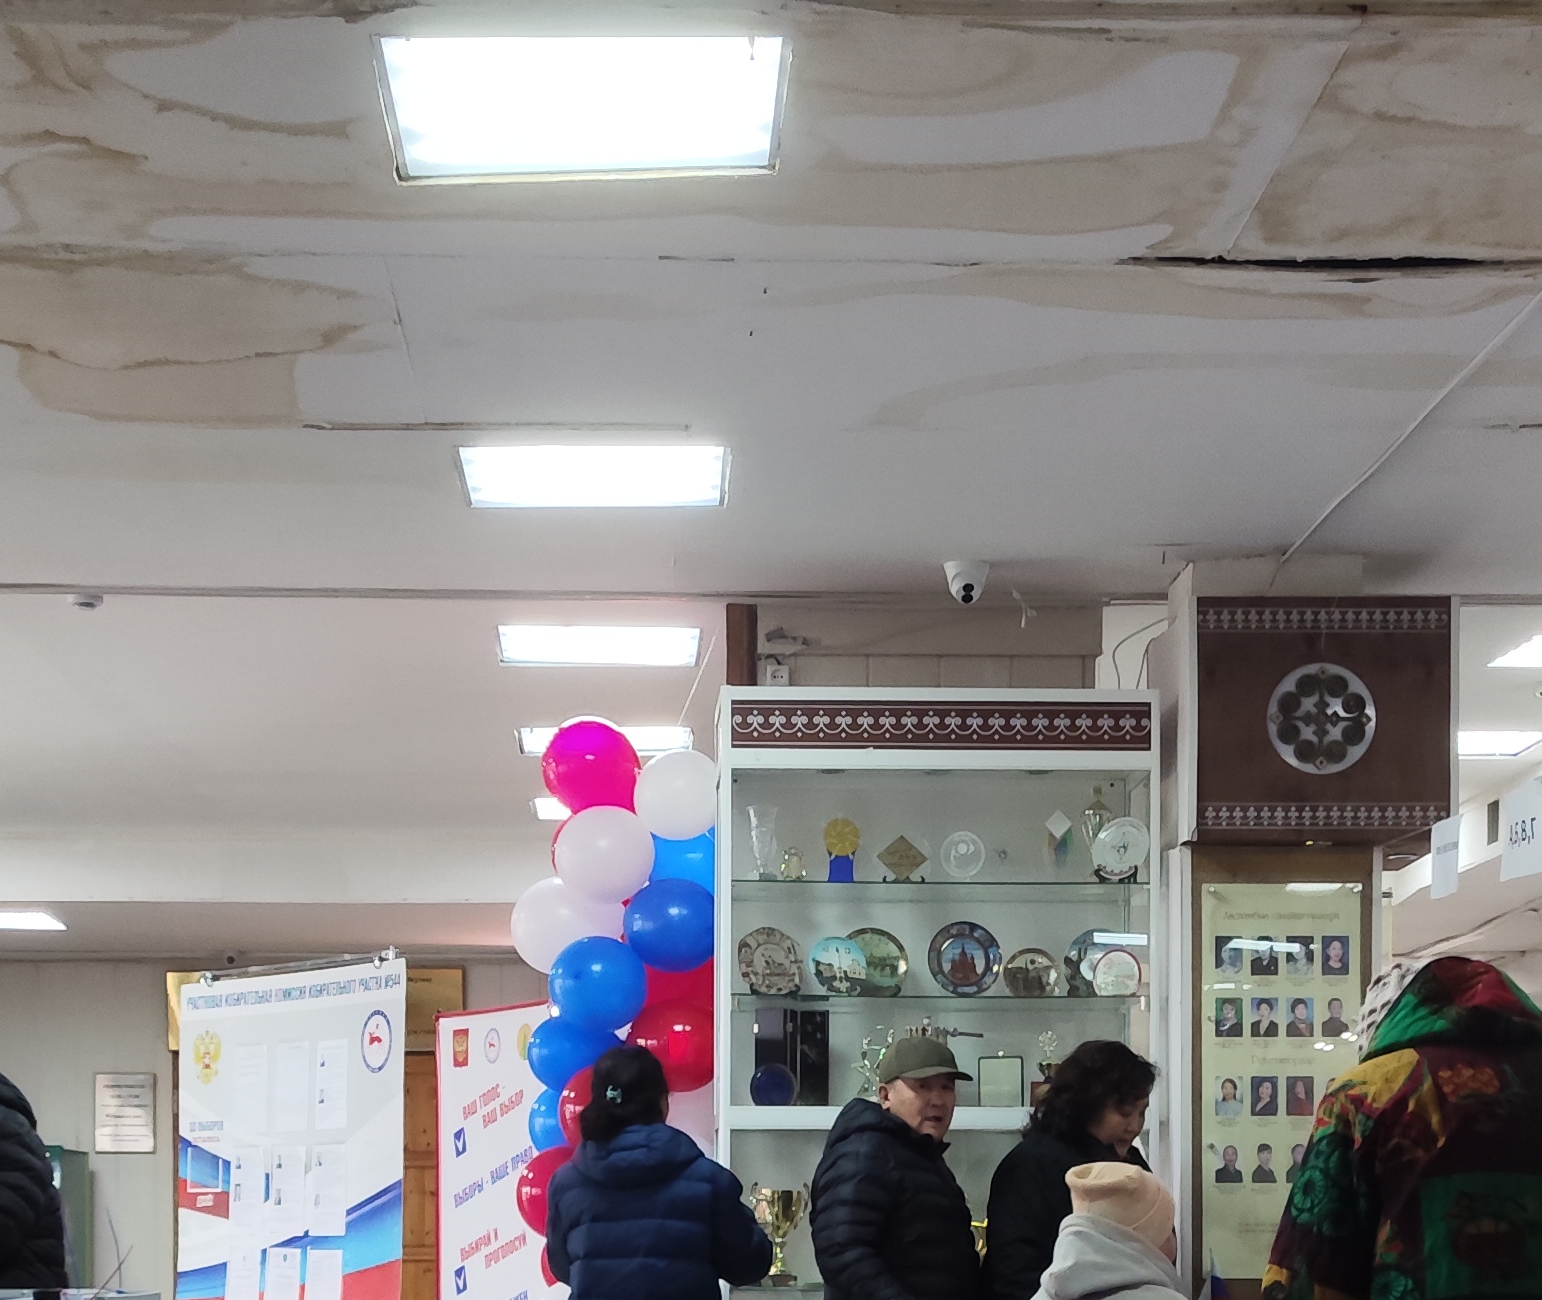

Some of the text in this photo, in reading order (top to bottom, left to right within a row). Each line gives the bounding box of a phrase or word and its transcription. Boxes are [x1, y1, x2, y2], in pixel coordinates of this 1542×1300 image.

[463, 1099, 477, 1120] ВАШ
[479, 1084, 500, 1109] ГОЛОС
[482, 1089, 524, 1129] ВАШ ВЫБОР
[454, 1177, 484, 1208] ВЫБОРЫ
[490, 1161, 509, 1185] ВАШЕ
[460, 1229, 491, 1262] ВЫБИРАЙ
